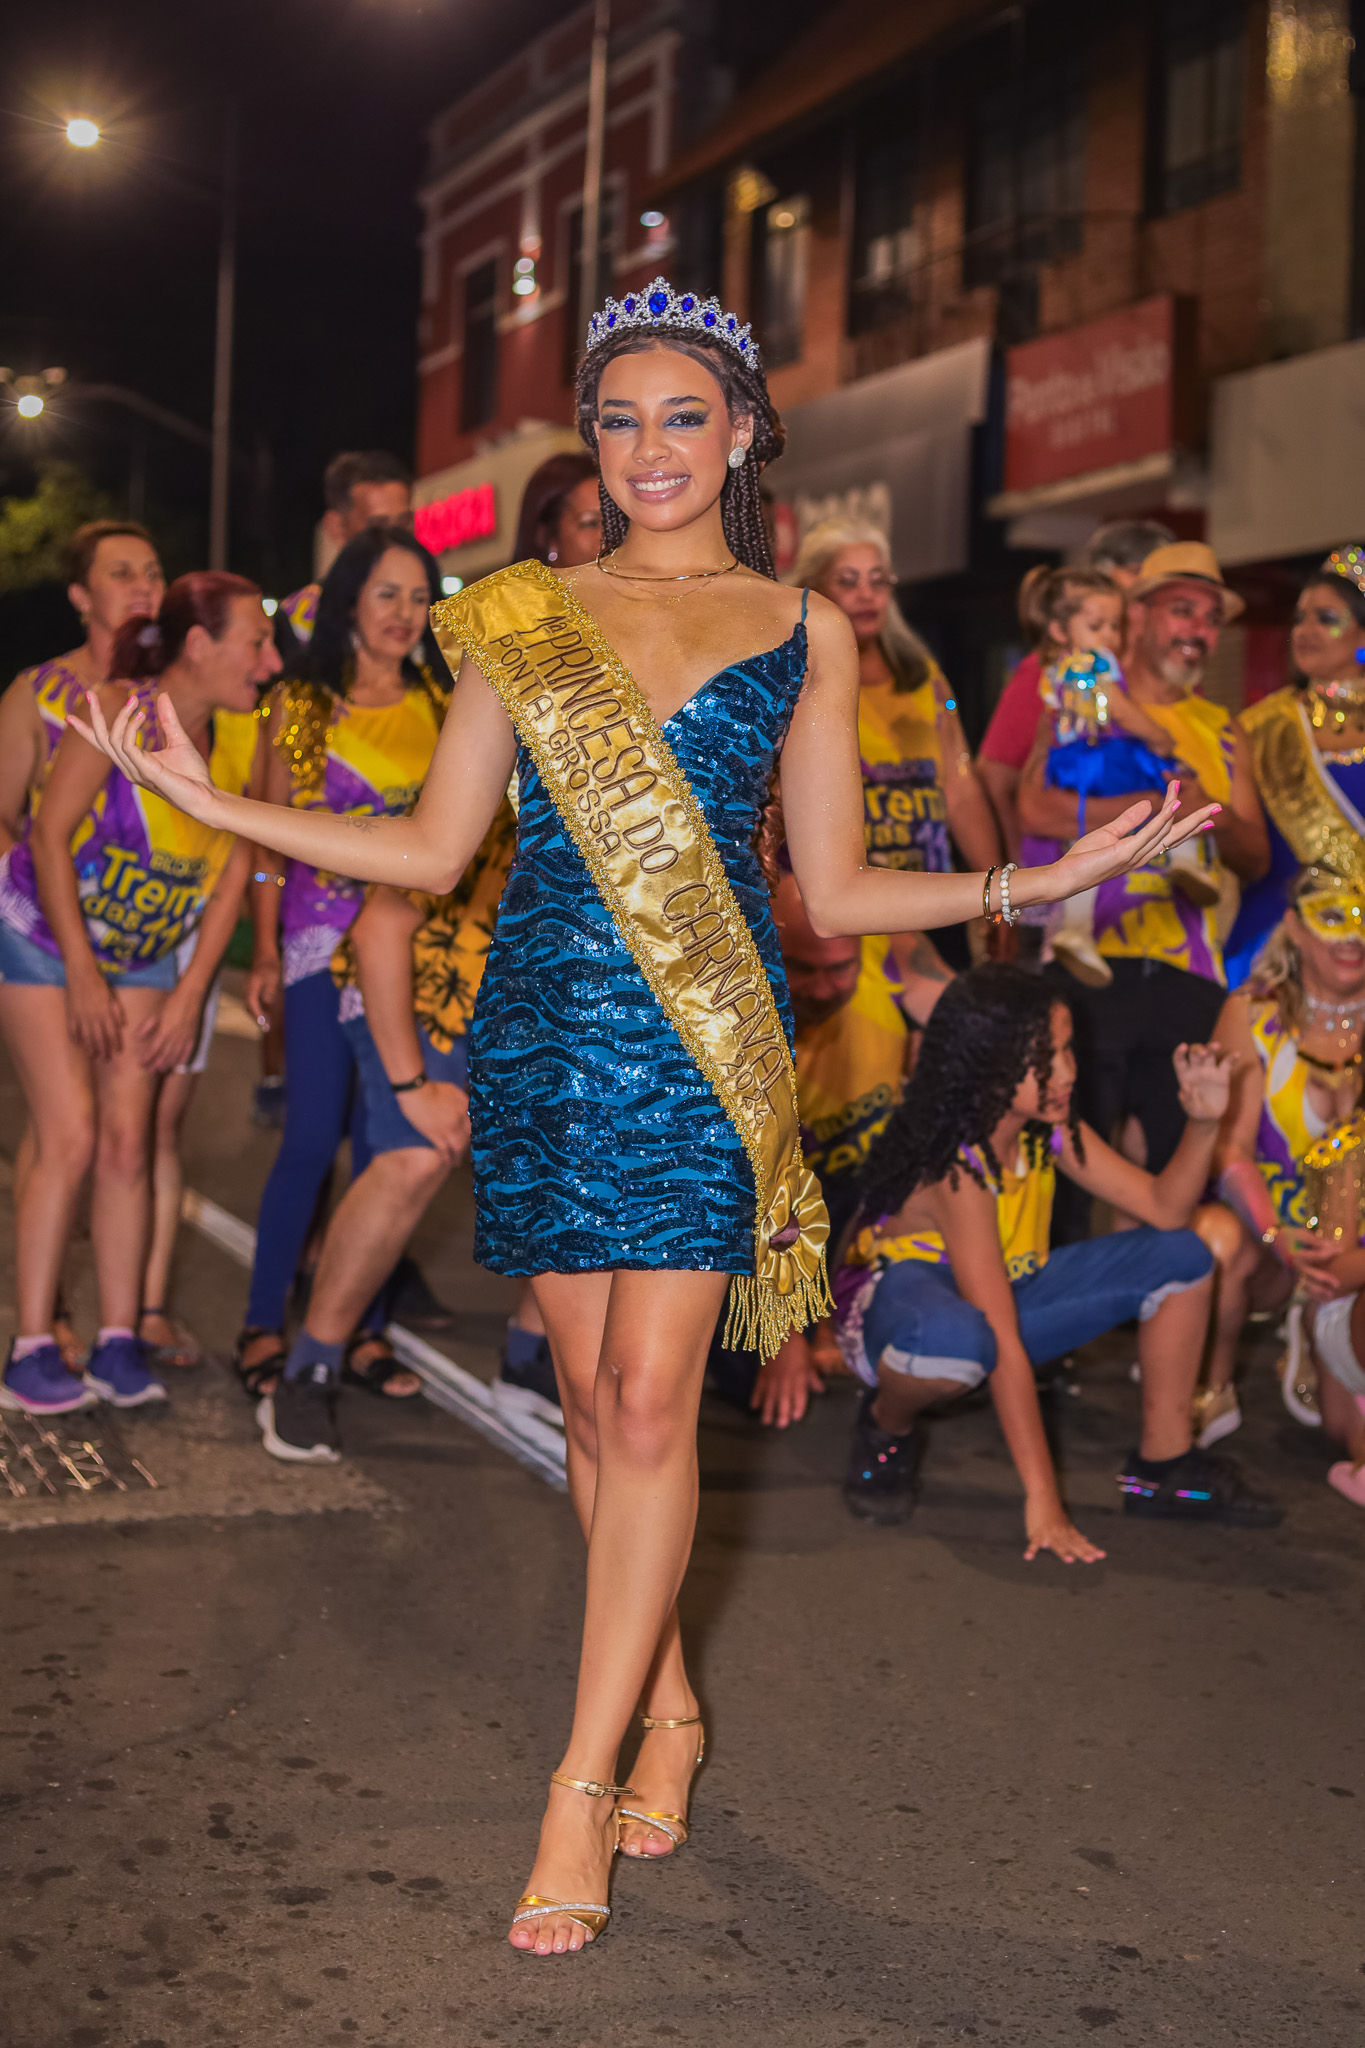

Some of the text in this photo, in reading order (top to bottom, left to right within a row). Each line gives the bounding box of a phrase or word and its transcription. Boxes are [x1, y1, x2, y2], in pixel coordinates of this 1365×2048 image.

[489, 633, 622, 857] PONTA GROSSA
[864, 785, 946, 823] rem
[101, 845, 203, 918] Trem
[525, 630, 659, 812] PRINCESA
[622, 815, 679, 874] DO
[662, 882, 788, 1117] CARNAVAL
[721, 1053, 765, 1127] 2026
